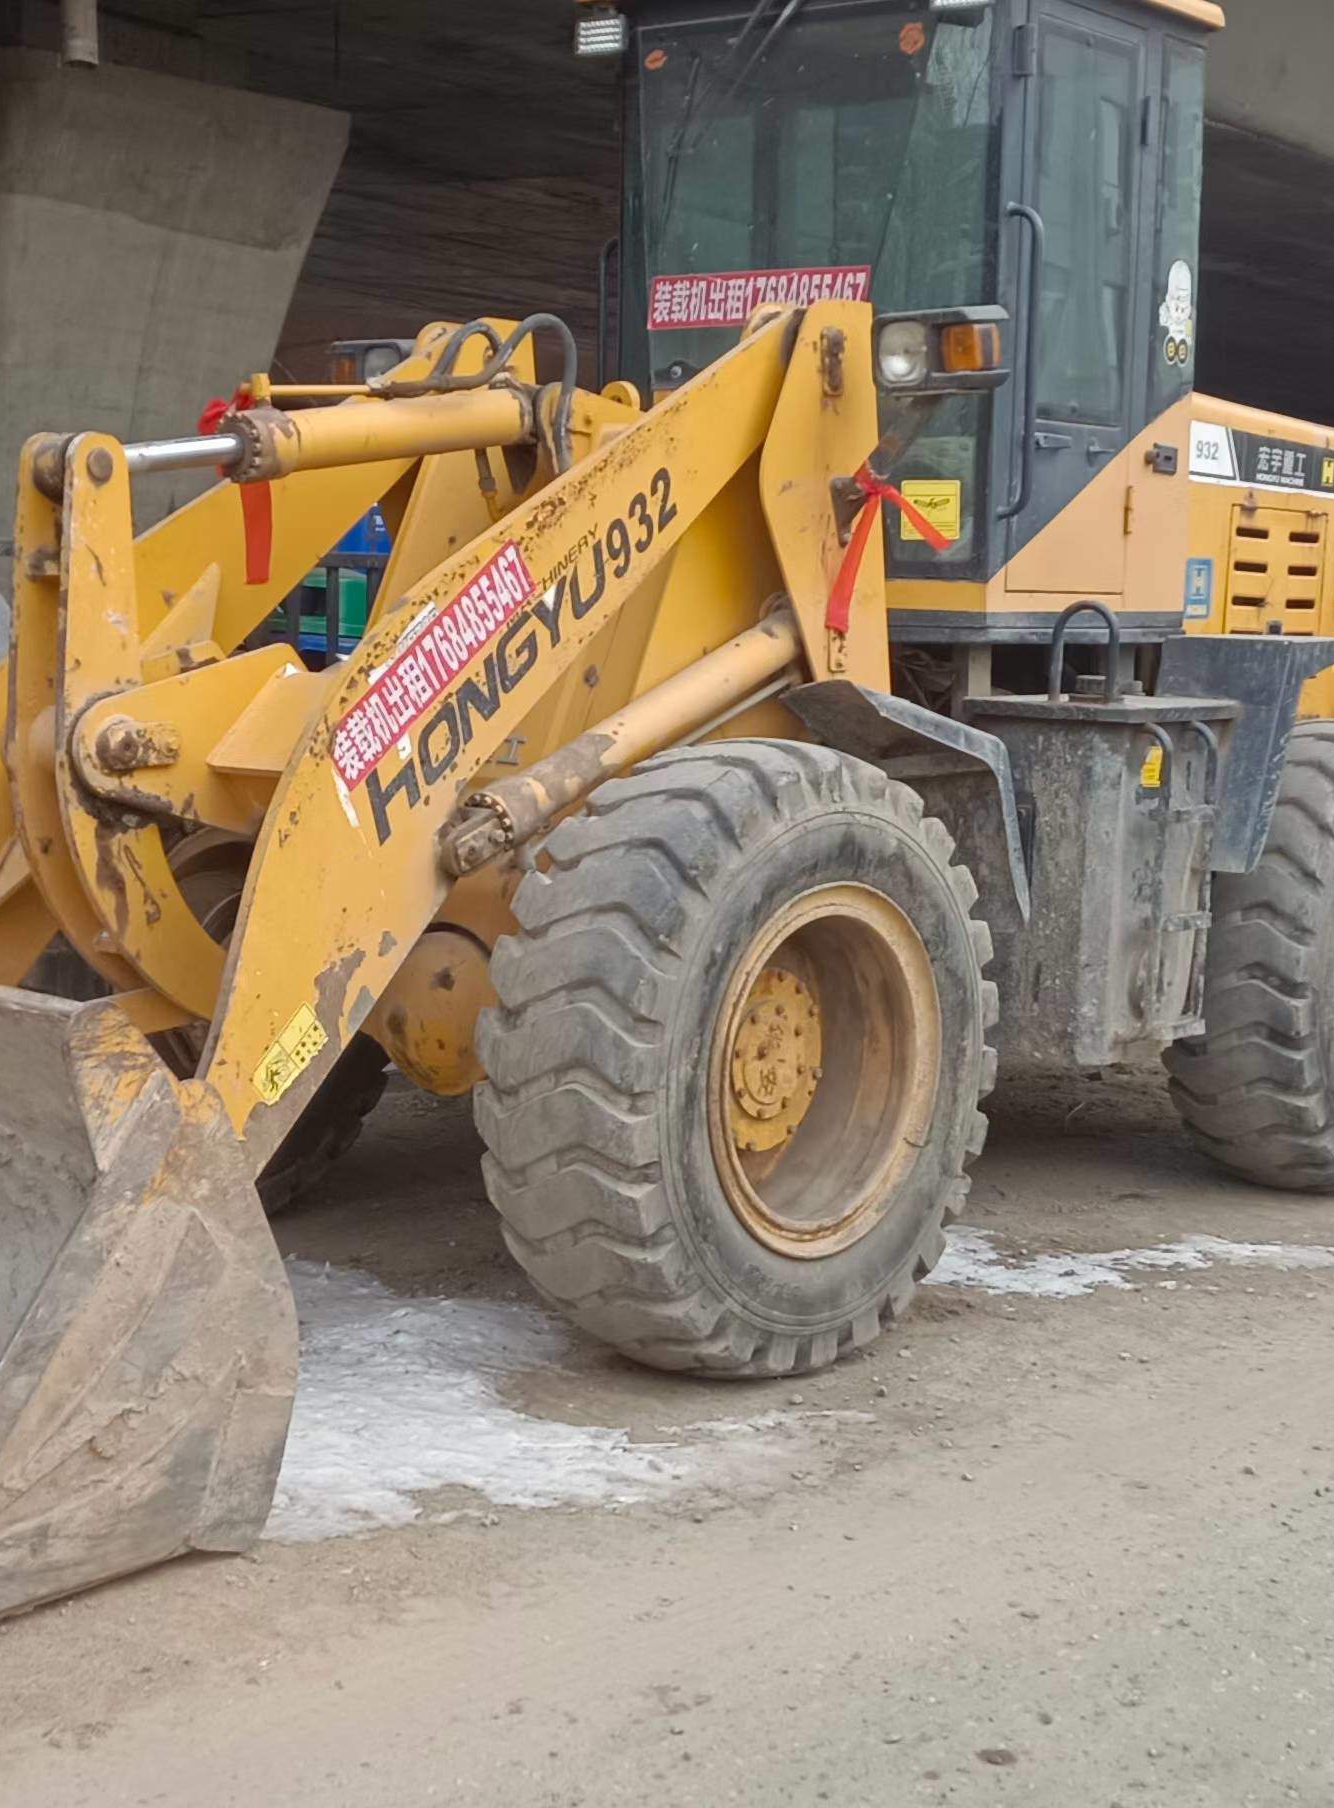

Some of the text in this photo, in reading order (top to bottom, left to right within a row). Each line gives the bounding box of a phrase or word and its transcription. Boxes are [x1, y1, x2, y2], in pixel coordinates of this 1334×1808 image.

[1196, 440, 1219, 461] 932
[1257, 446, 1308, 477] 宏宇重工
[332, 545, 531, 781] 装载机出租17684855467
